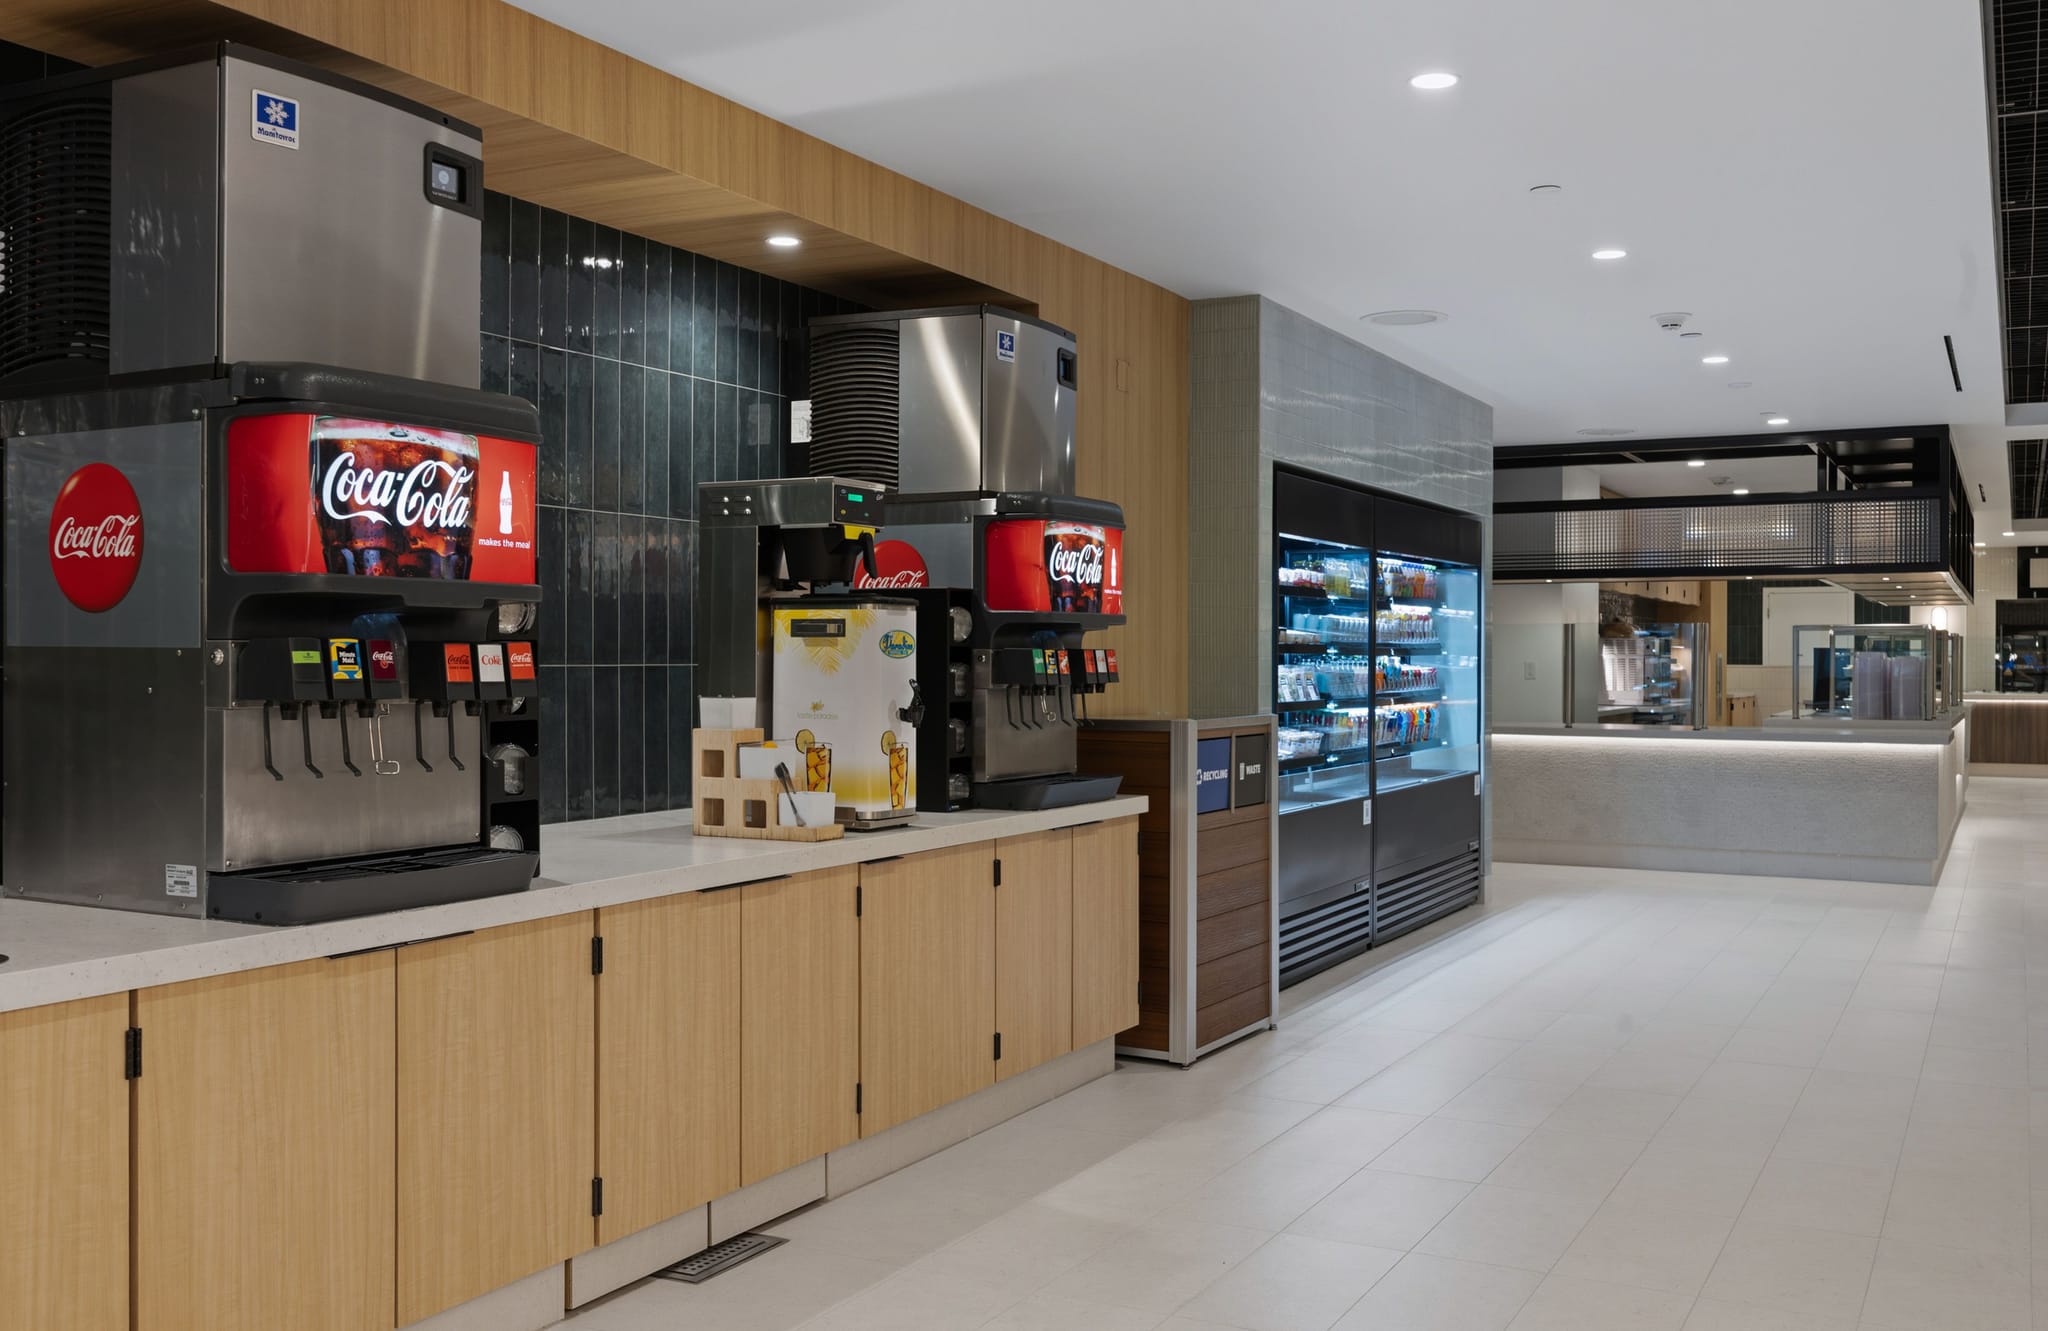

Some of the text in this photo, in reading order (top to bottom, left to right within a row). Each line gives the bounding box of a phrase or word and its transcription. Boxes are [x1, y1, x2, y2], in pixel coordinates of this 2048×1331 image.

[322, 452, 474, 528] Coca-Cola
[54, 515, 141, 559] Coca-Cola
[478, 538, 531, 550] makes the meal
[1049, 541, 1104, 584] Coca-Cola
[1203, 769, 1228, 782] RECYCLING
[1246, 764, 1261, 775] WASTE
